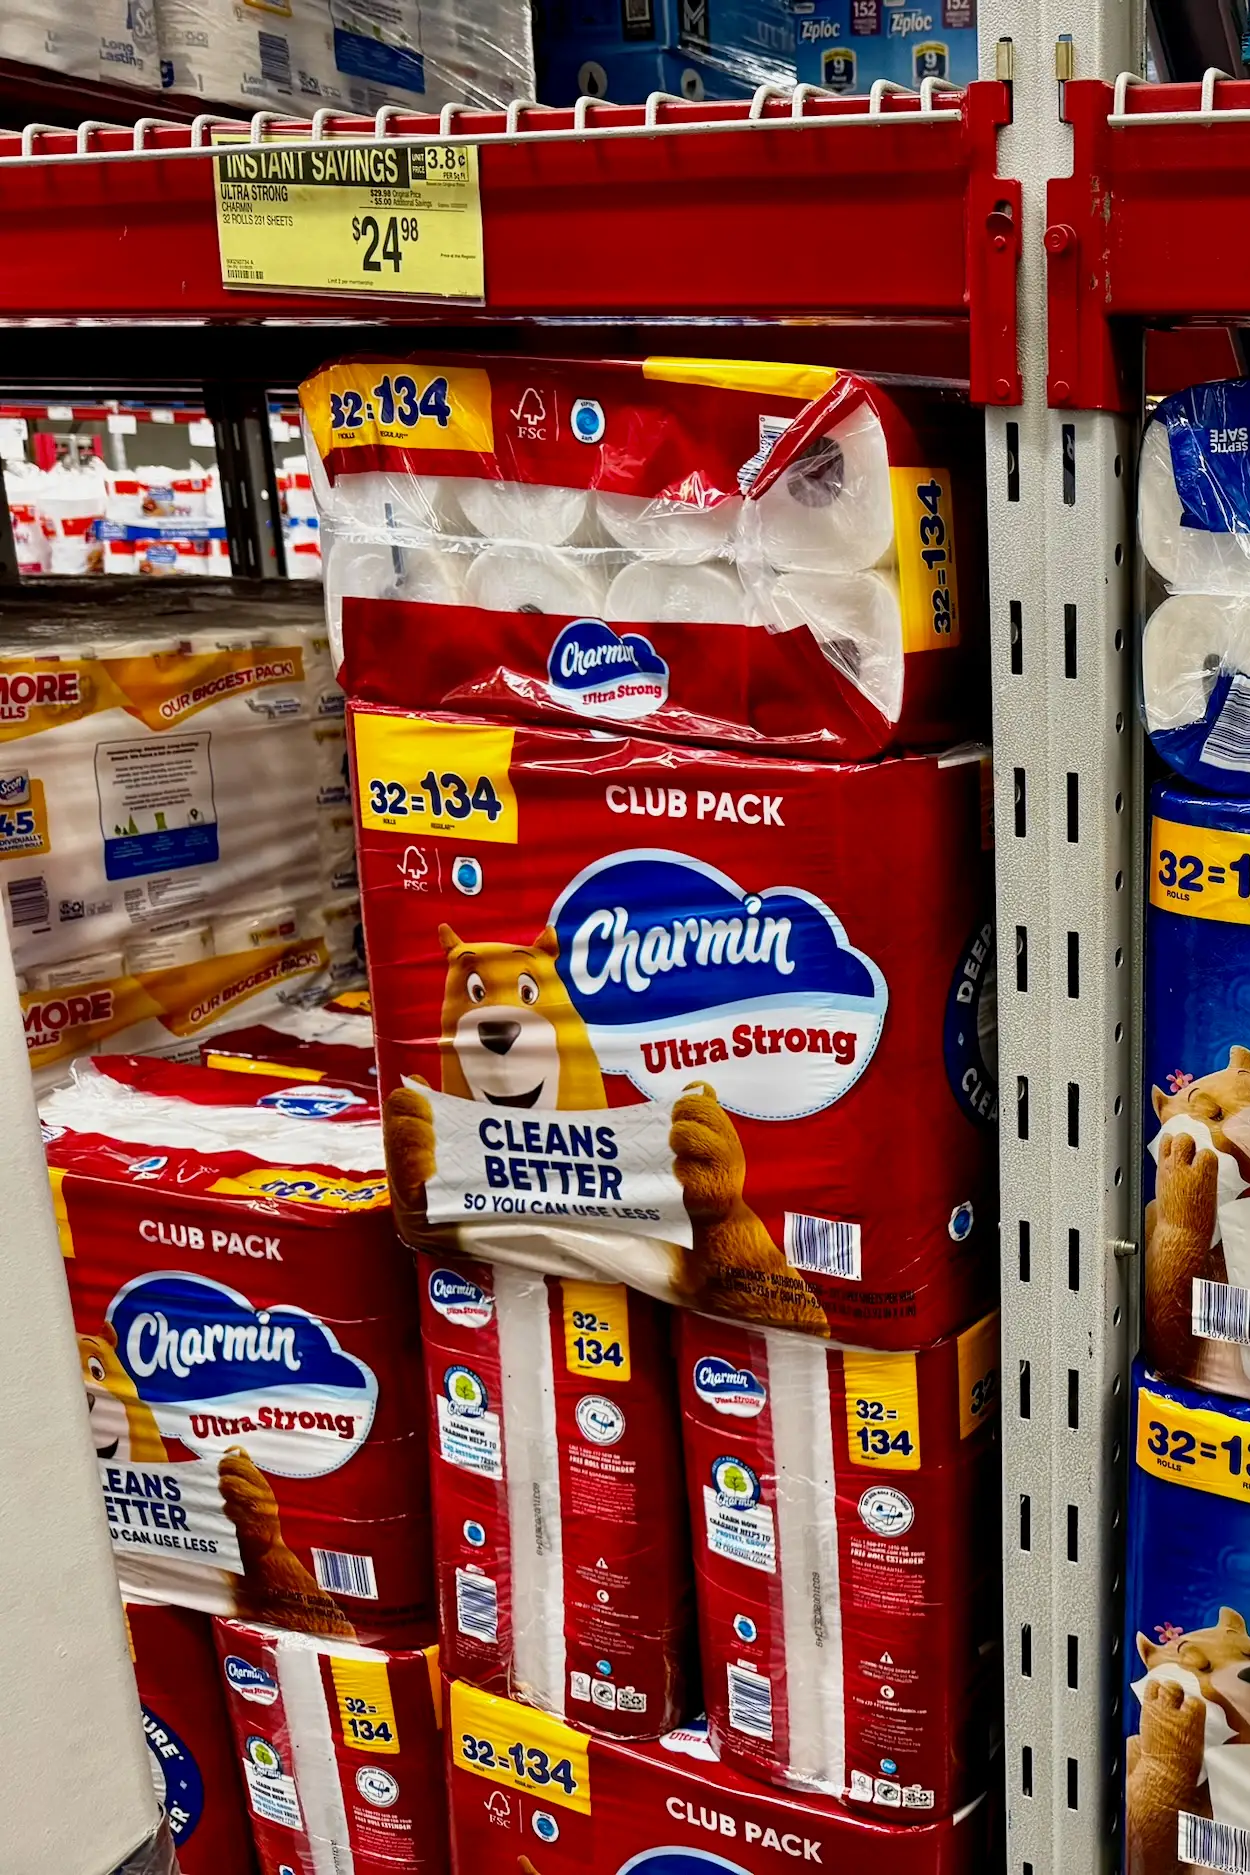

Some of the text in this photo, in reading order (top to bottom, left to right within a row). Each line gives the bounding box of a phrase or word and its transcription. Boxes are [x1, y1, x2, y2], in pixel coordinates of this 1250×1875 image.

[802, 20, 840, 43] Ziploc
[892, 13, 932, 37] Ziploc
[226, 147, 398, 184] INSTANT SAVINGS
[220, 184, 288, 202] ULTRA STRONG
[221, 201, 253, 213] CHARMIN
[222, 213, 294, 227] 32 ROLLS SHEETS
[517, 426, 547, 440] FSC
[1210, 427, 1248, 440] SAFE
[1210, 441, 1248, 454] SEPTIC
[560, 627, 637, 676] Charmin
[160, 660, 295, 719] OUR BIGGEST PACK!
[583, 680, 662, 706] Ultra Strong
[604, 784, 786, 827] CLUB PACK
[403, 880, 428, 893] FSC
[1165, 889, 1191, 902] ROLLS
[566, 894, 796, 995] Charmin
[190, 962, 279, 1023] OUR BIGGEST
[640, 1021, 858, 1075] Ultra Strong
[477, 1116, 619, 1161] CLEANS
[483, 1154, 624, 1200] BETTER
[463, 1193, 487, 1211] SO
[491, 1195, 527, 1214] YOU
[530, 1199, 570, 1217] CAN
[574, 1203, 608, 1220] USE
[139, 1219, 284, 1262] CLUB PACK
[434, 1278, 477, 1300] Charmin
[126, 1310, 302, 1378] Charmin
[573, 1336, 624, 1367] 134
[699, 1365, 749, 1388] Charmin
[190, 1406, 356, 1439] Ultra Strong
[856, 1427, 914, 1456] 134
[1156, 1458, 1182, 1473] ROLLS
[106, 1494, 191, 1532] ETTER
[121, 1529, 152, 1546] CAN
[153, 1532, 180, 1549] USE
[228, 1663, 265, 1682] Charmin
[348, 1718, 393, 1742] 134
[488, 1816, 512, 1829] FSC
[665, 1796, 824, 1864] CLUB PACK
